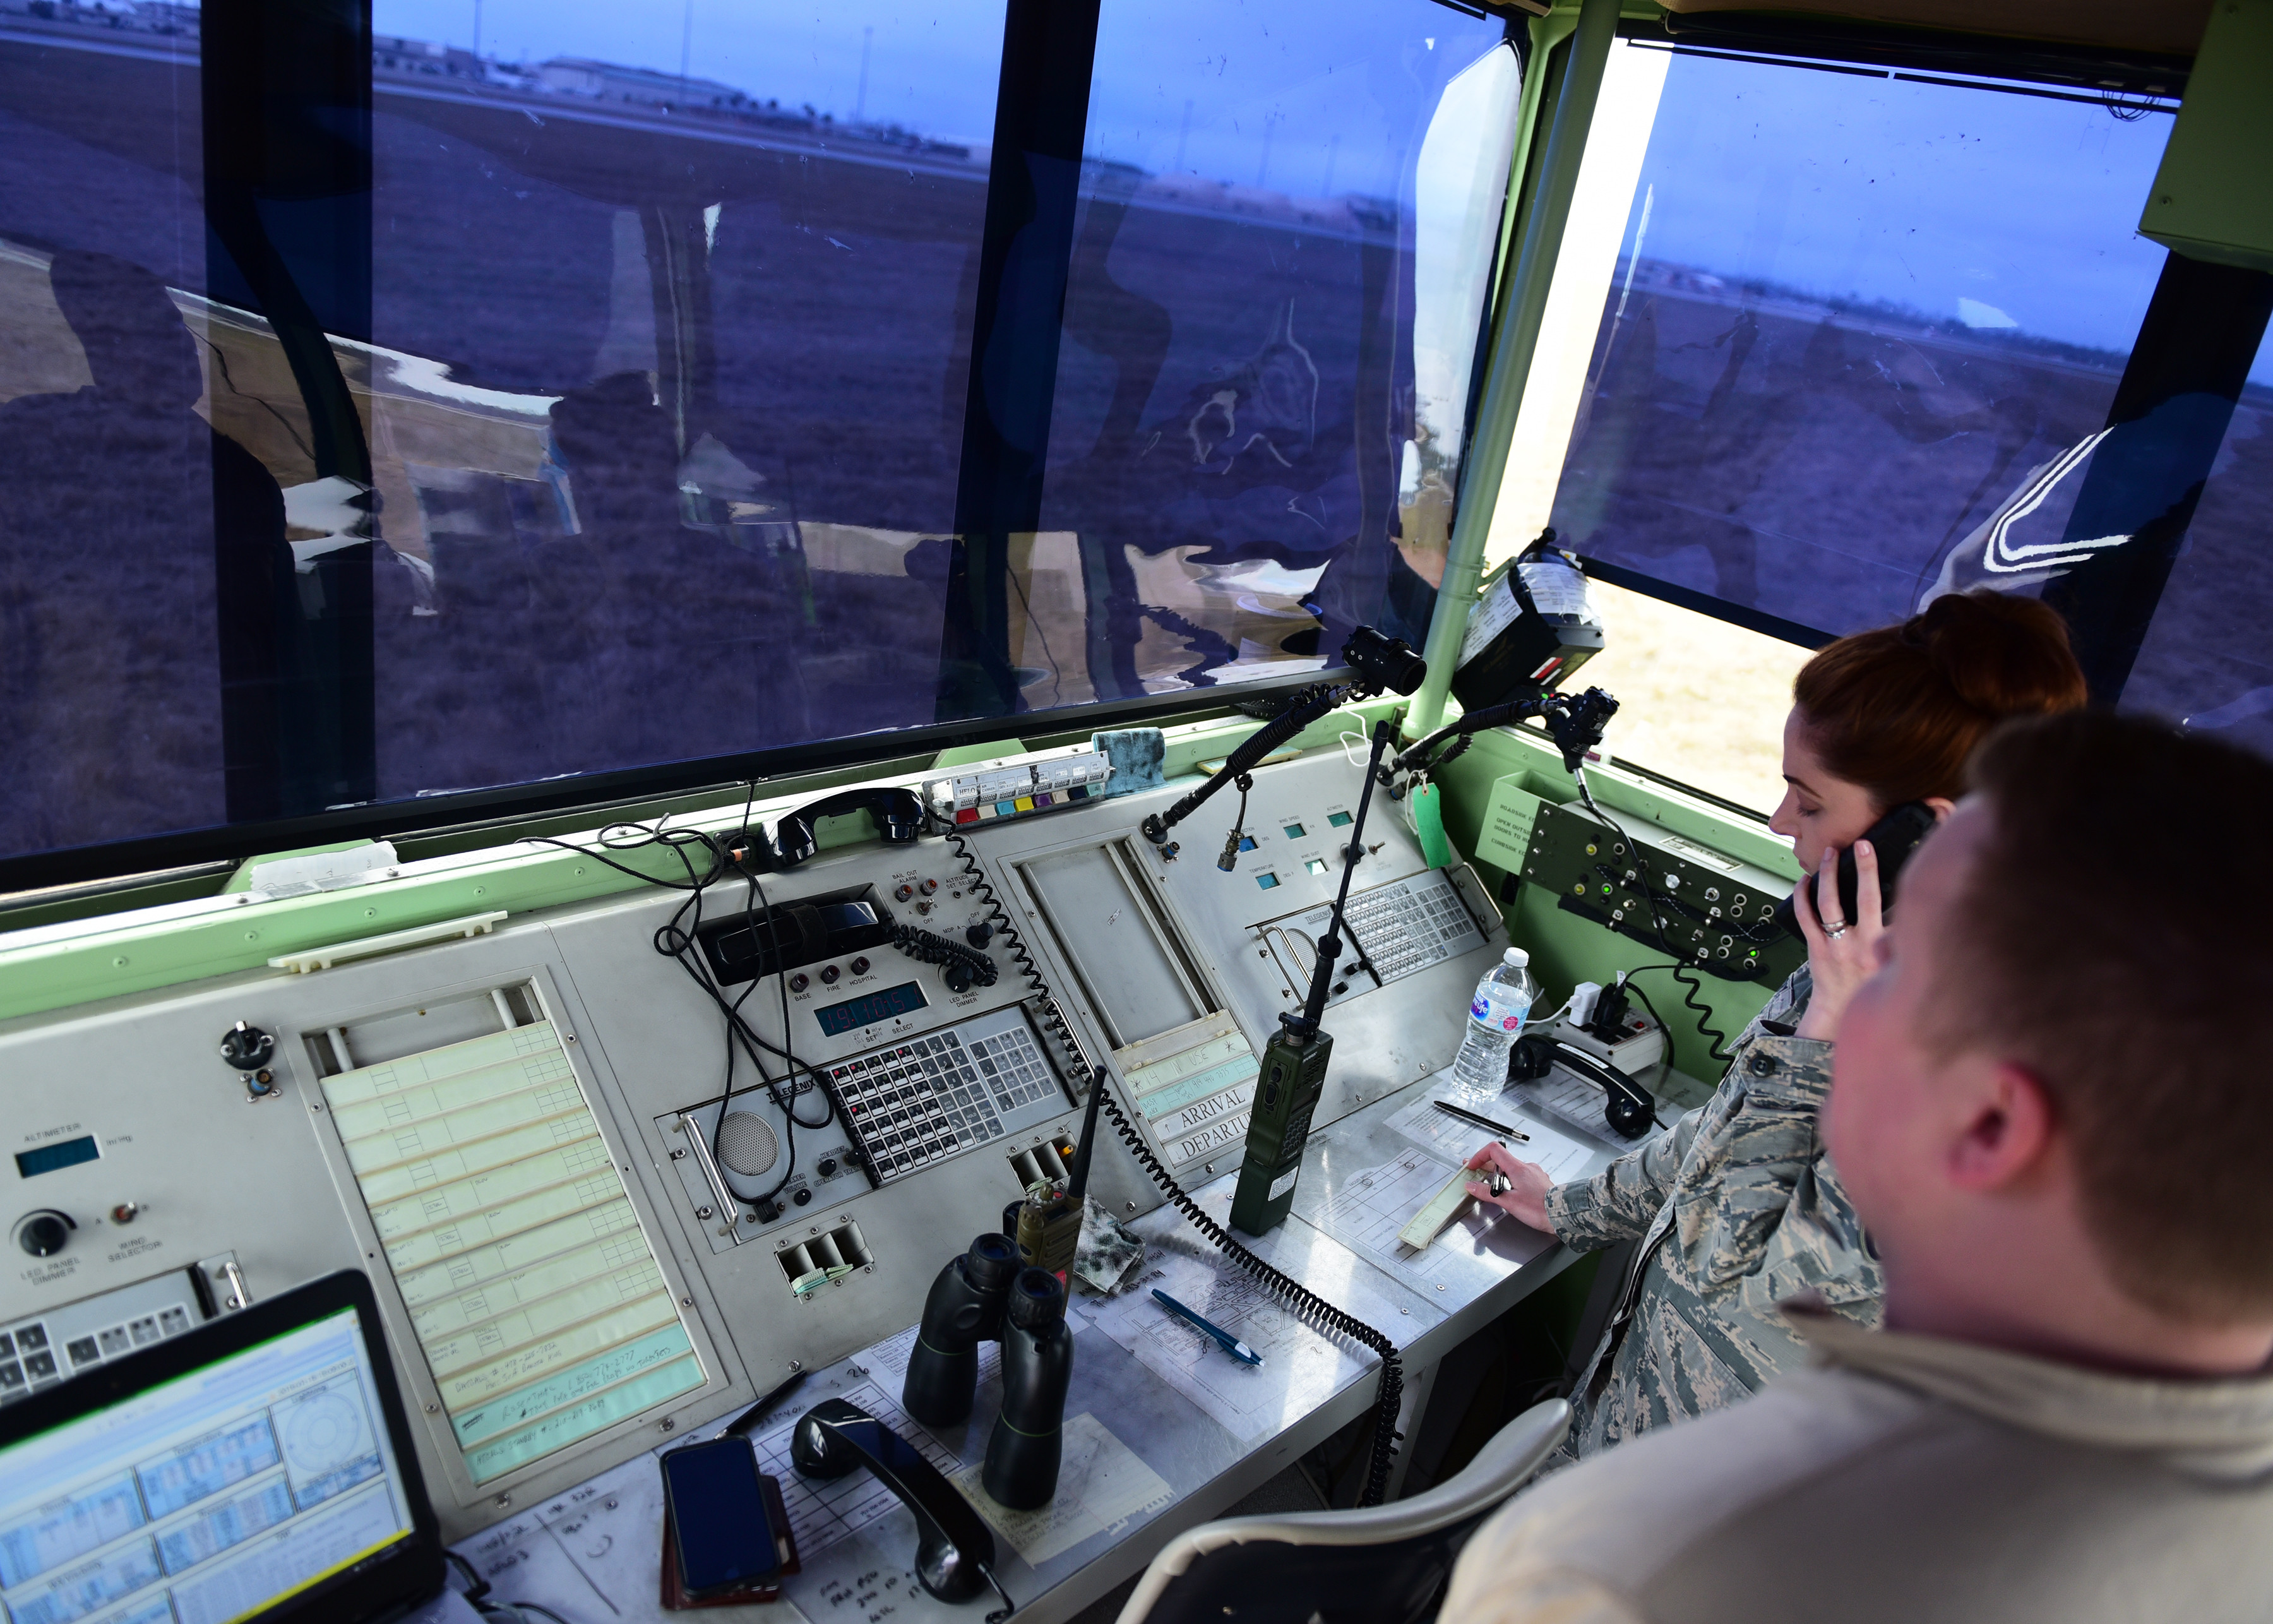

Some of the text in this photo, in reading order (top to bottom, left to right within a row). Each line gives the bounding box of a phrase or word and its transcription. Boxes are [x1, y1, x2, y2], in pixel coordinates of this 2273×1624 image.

[1500, 804, 1527, 818] ROADSIDE
[1496, 817, 1511, 827] OPEN
[1494, 825, 1512, 835] DOORS
[1491, 838, 1518, 852] CURBSIDE
[1249, 864, 1275, 875] TEMPERATURE
[898, 876, 917, 884] ALARM
[946, 874, 970, 883] ALTITUDE
[958, 878, 978, 887] SELECT
[1304, 908, 1332, 923] TELEGENIX
[849, 974, 878, 986] HOSPITAL
[826, 984, 841, 993] FIRE
[794, 993, 811, 1002] BASE
[949, 991, 979, 1005] LED PANEL
[956, 997, 978, 1008] DIMMER
[892, 1023, 914, 1034] SELECT
[866, 1034, 877, 1042] SET
[1143, 1046, 1209, 1087] 14 IN USE
[766, 1077, 816, 1101] TLEGENIX
[1181, 1089, 1246, 1128] ARRIVAL
[24, 1123, 81, 1142] ALTIMETER
[1181, 1111, 1252, 1157] DEPARTU
[820, 1145, 845, 1159] HEADSET
[813, 1170, 844, 1188] OPERATOR
[784, 1181, 808, 1195] VOLUME
[118, 1236, 147, 1250] WIND
[108, 1241, 164, 1263] SELECTOR
[20, 1257, 81, 1281] LED PANEL
[32, 1267, 77, 1286] DIMMER
